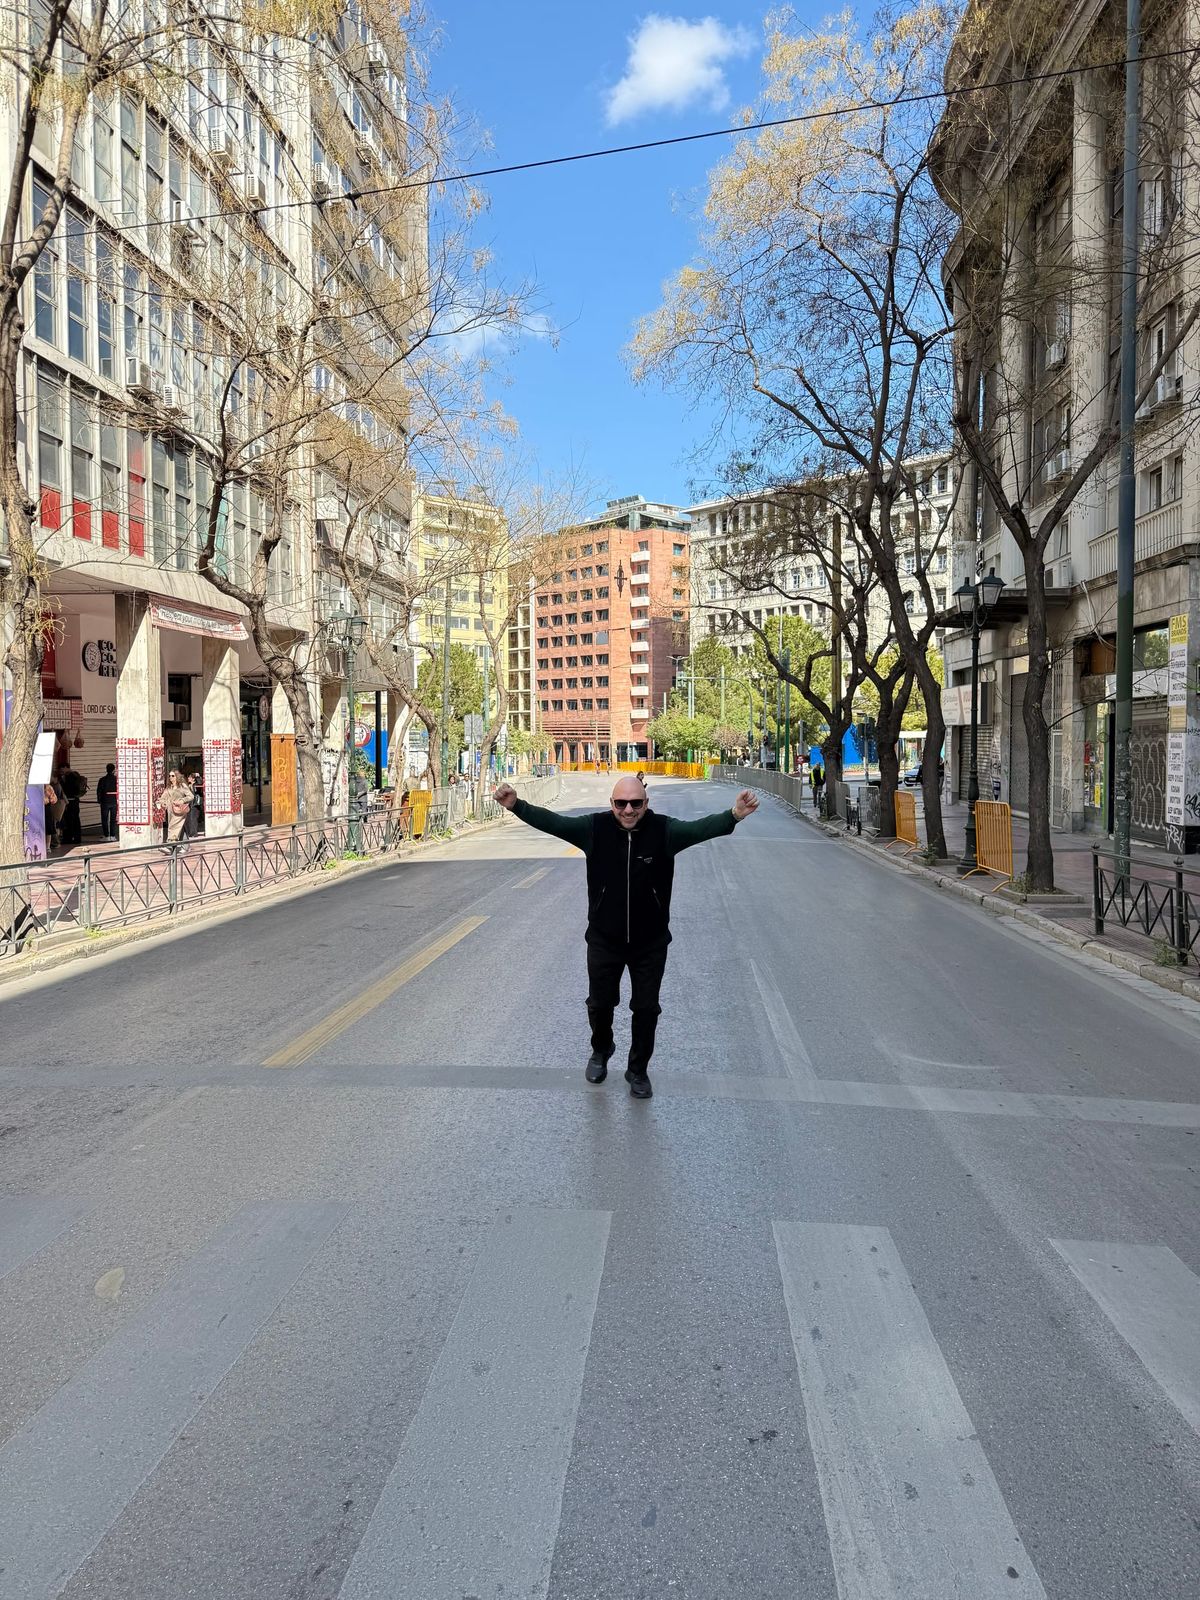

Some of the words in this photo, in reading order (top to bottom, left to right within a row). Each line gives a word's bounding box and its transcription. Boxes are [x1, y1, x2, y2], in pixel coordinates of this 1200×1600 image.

[1171, 615, 1187, 630] FMS
[84, 704, 98, 714] LORD
[99, 704, 107, 714] OF
